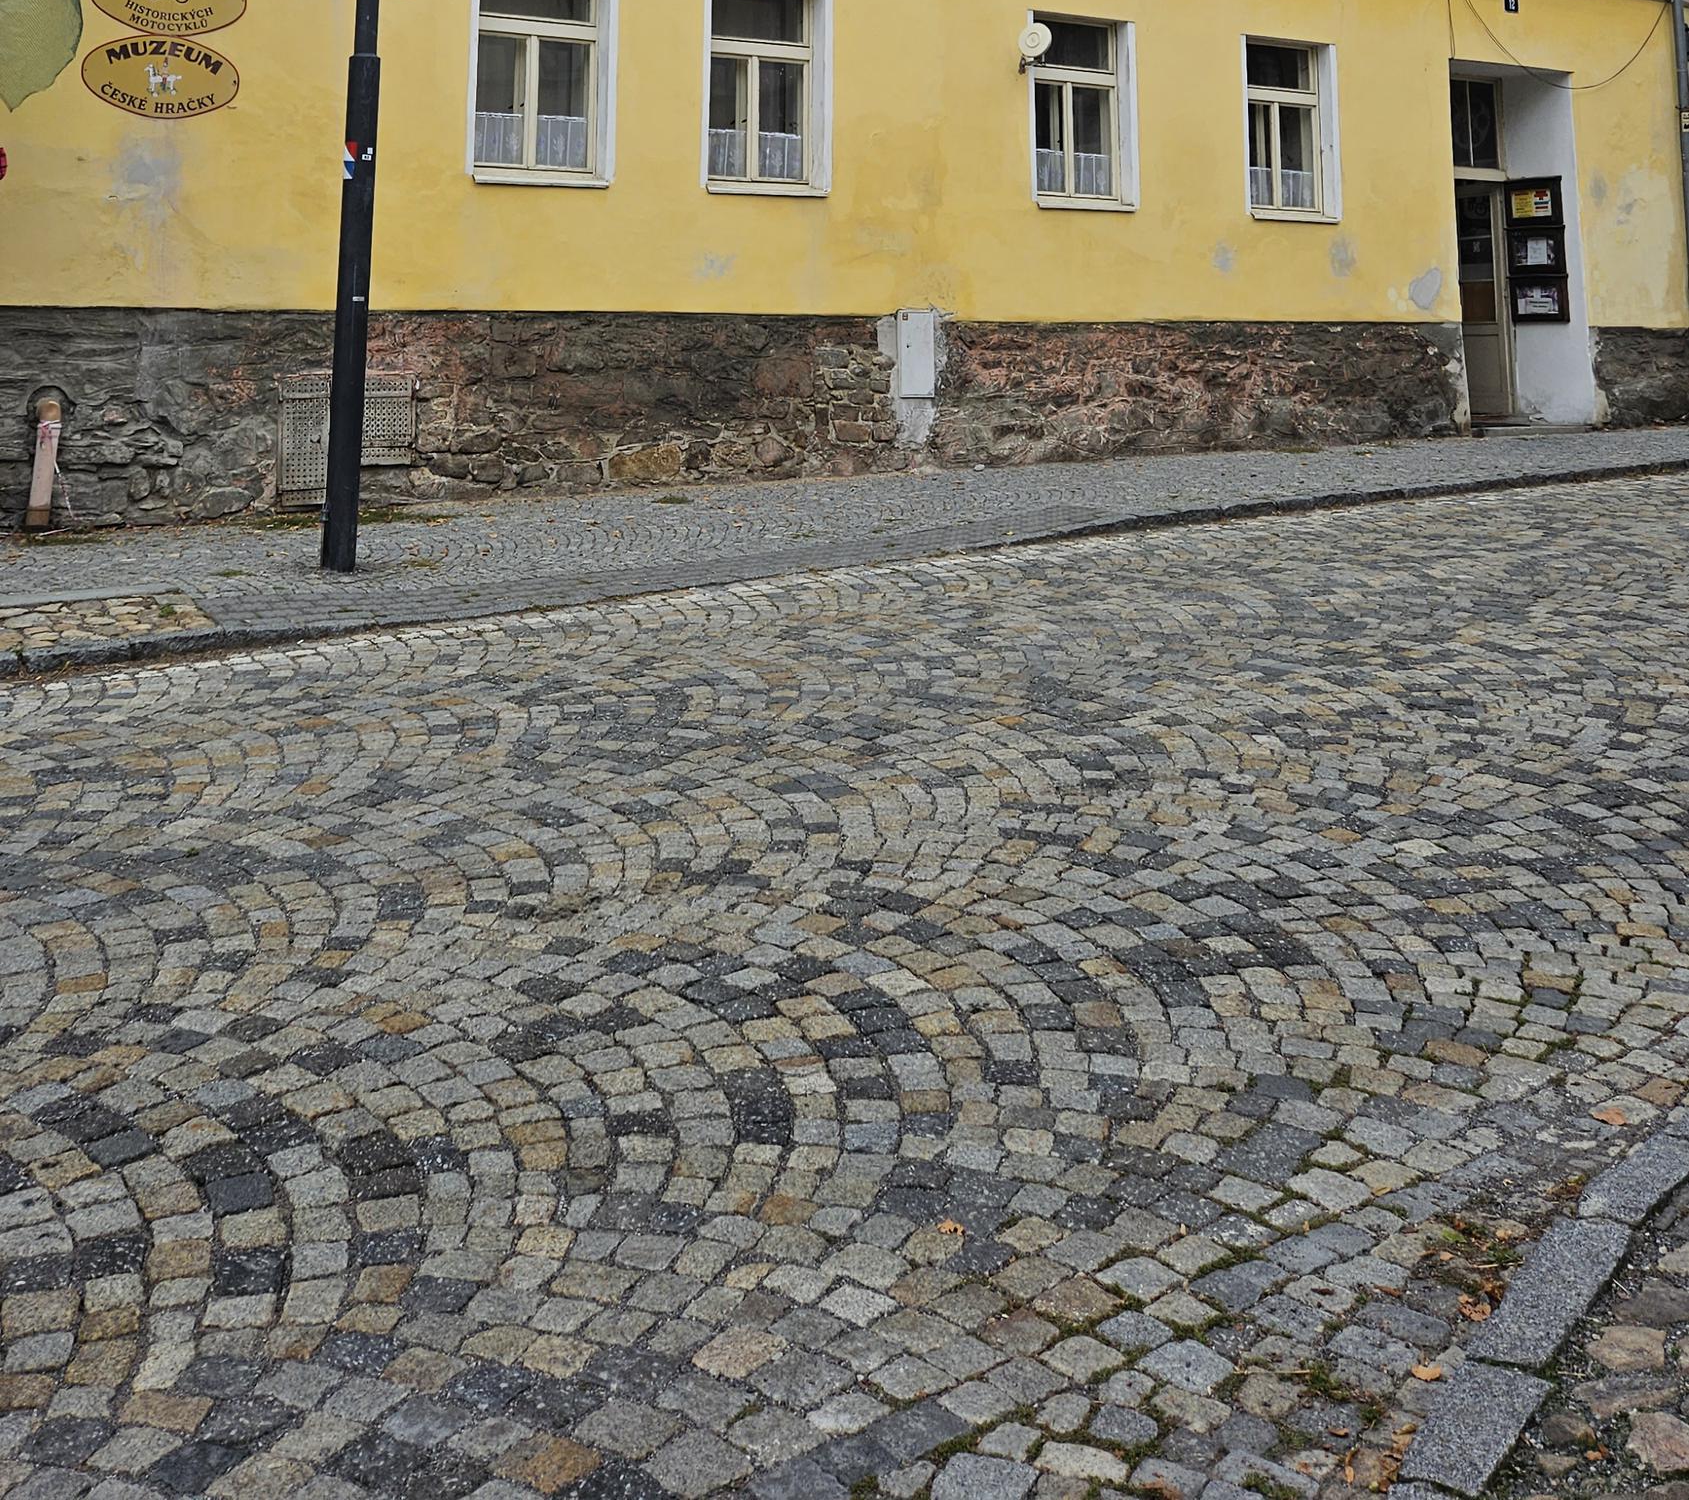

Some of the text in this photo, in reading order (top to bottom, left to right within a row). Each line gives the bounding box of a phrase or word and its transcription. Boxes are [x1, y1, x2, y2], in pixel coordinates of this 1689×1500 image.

[124, 0, 214, 21] HISTORICKÝCH
[129, 13, 209, 32] MOTOCYKLŮ
[105, 40, 223, 75] MUZEUM
[100, 81, 216, 114] ČESKÉ HRAČKY
